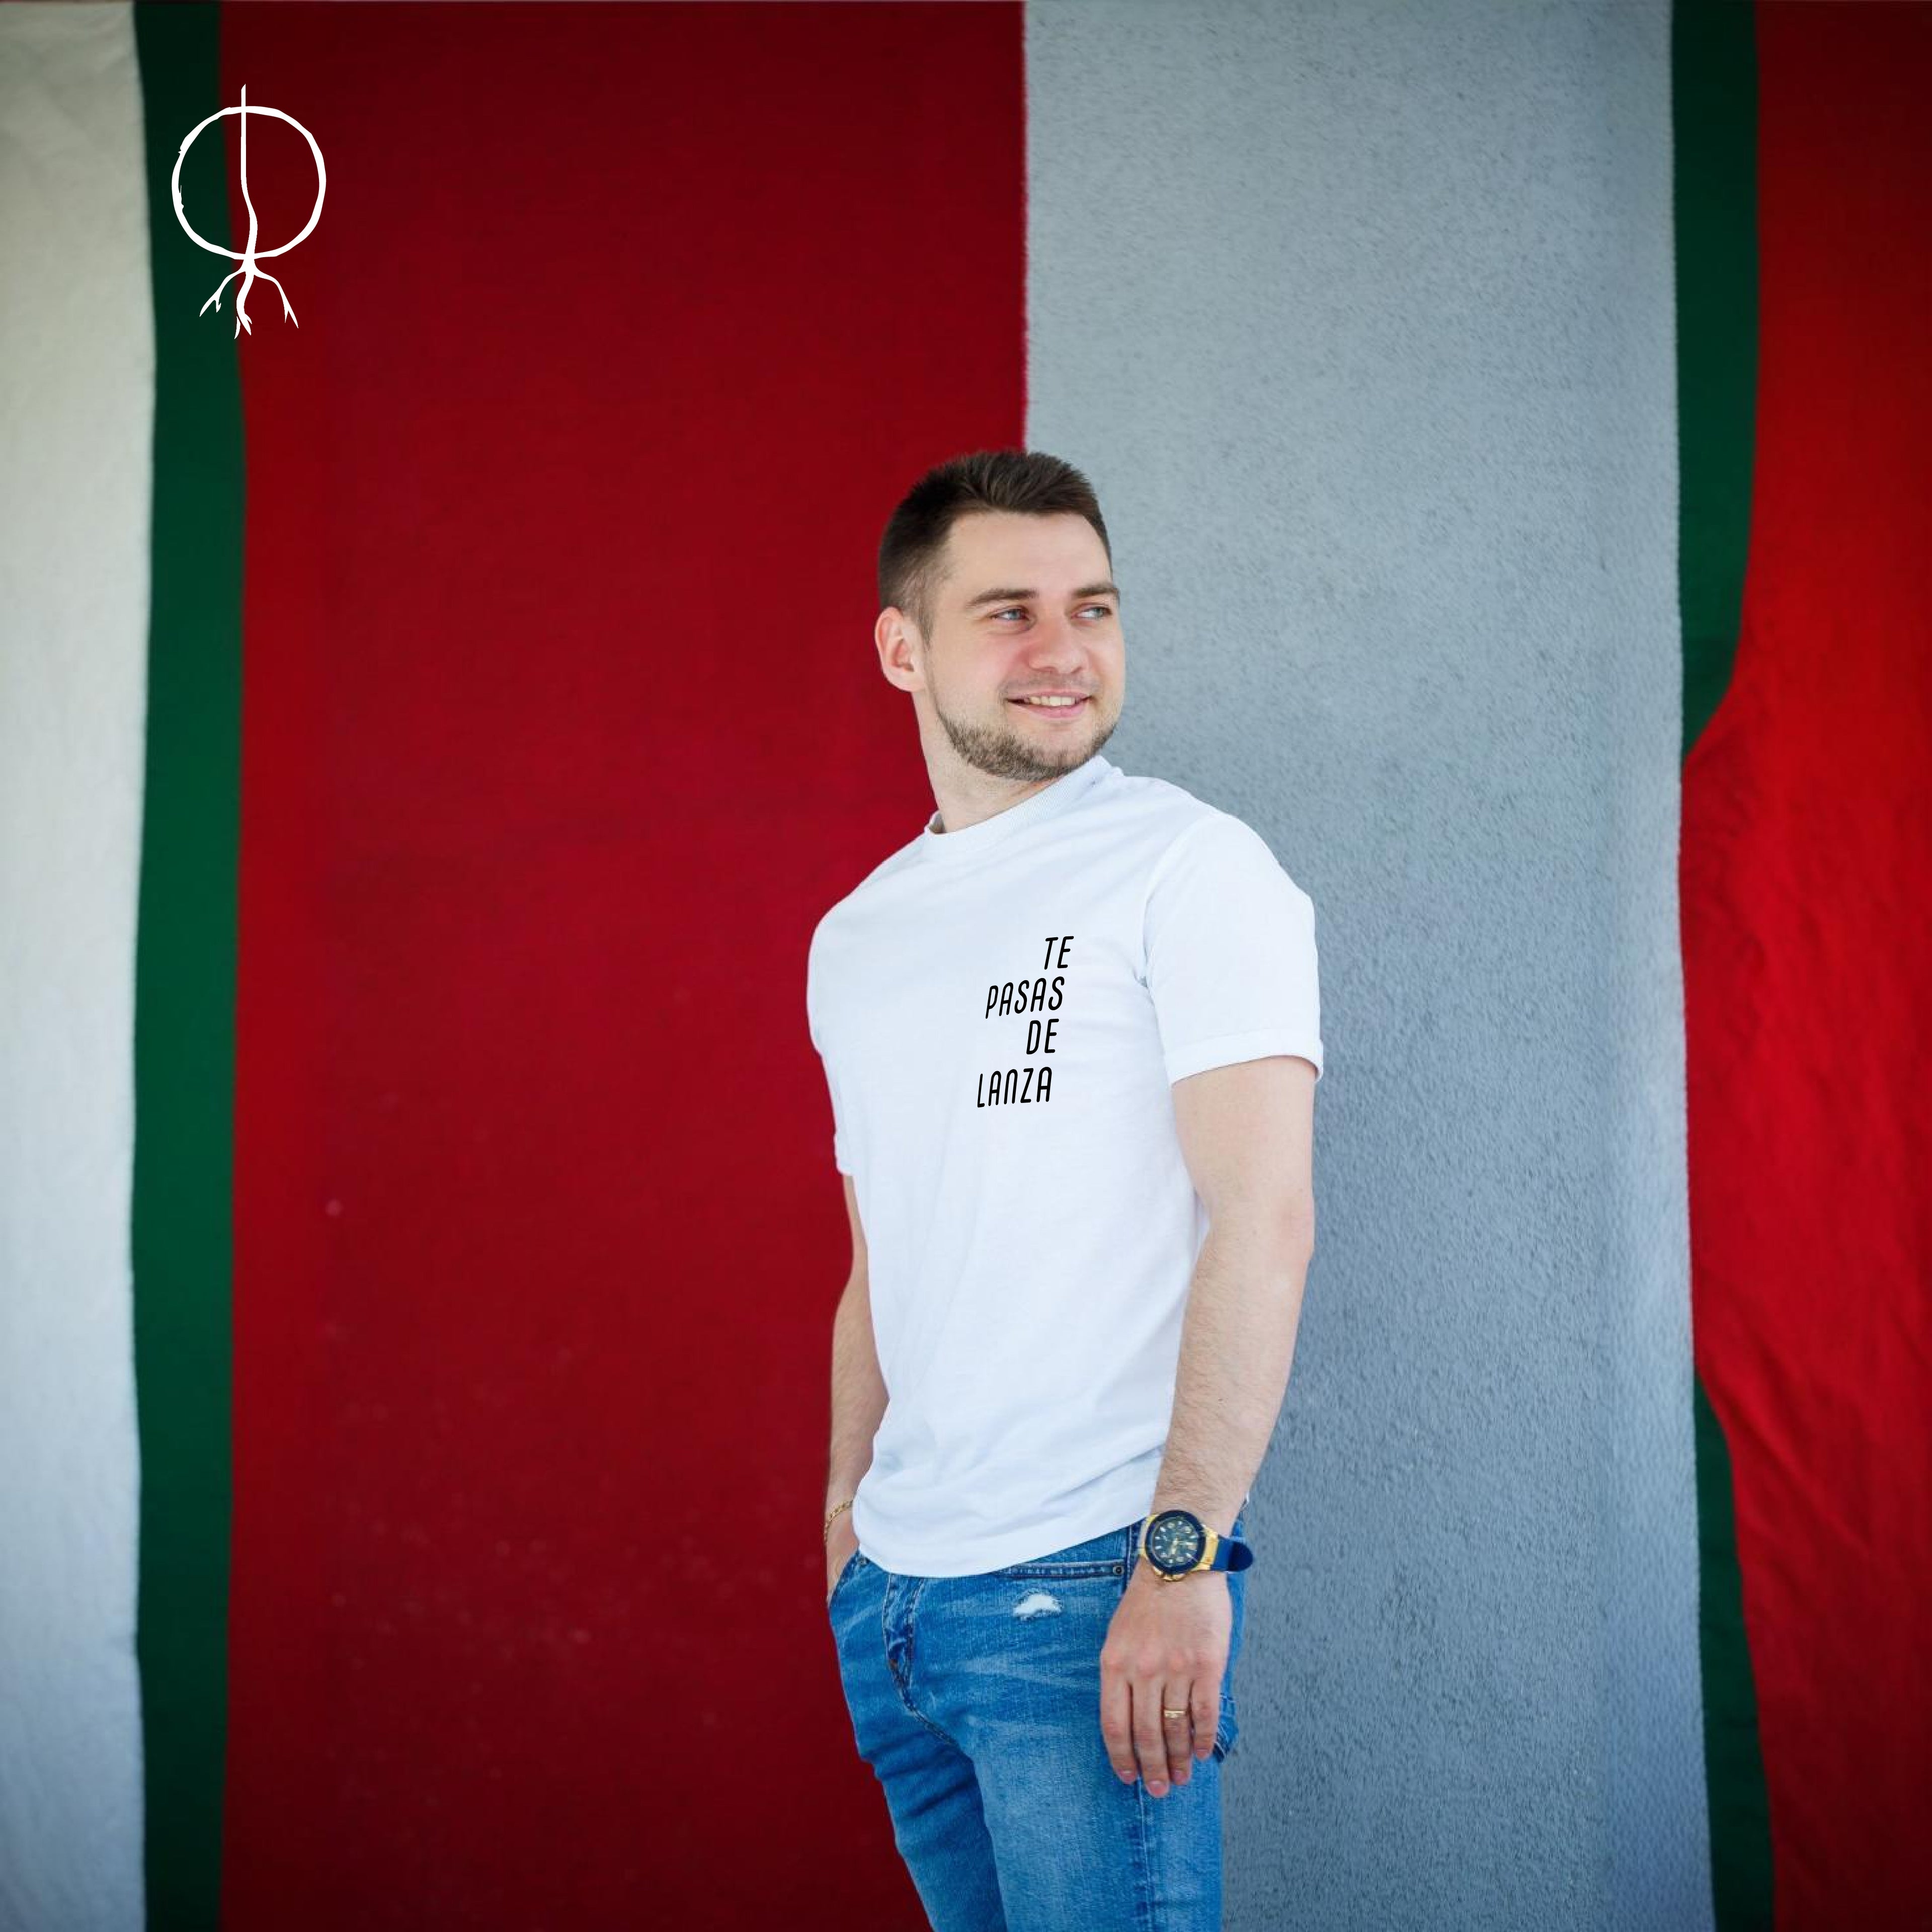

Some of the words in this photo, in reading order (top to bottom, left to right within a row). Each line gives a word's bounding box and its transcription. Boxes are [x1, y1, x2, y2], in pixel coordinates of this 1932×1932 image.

[1044, 936, 1074, 970] TE
[985, 976, 1065, 1019] PASAS
[1026, 1018, 1059, 1055] DE
[977, 1067, 1052, 1107] LANZA
